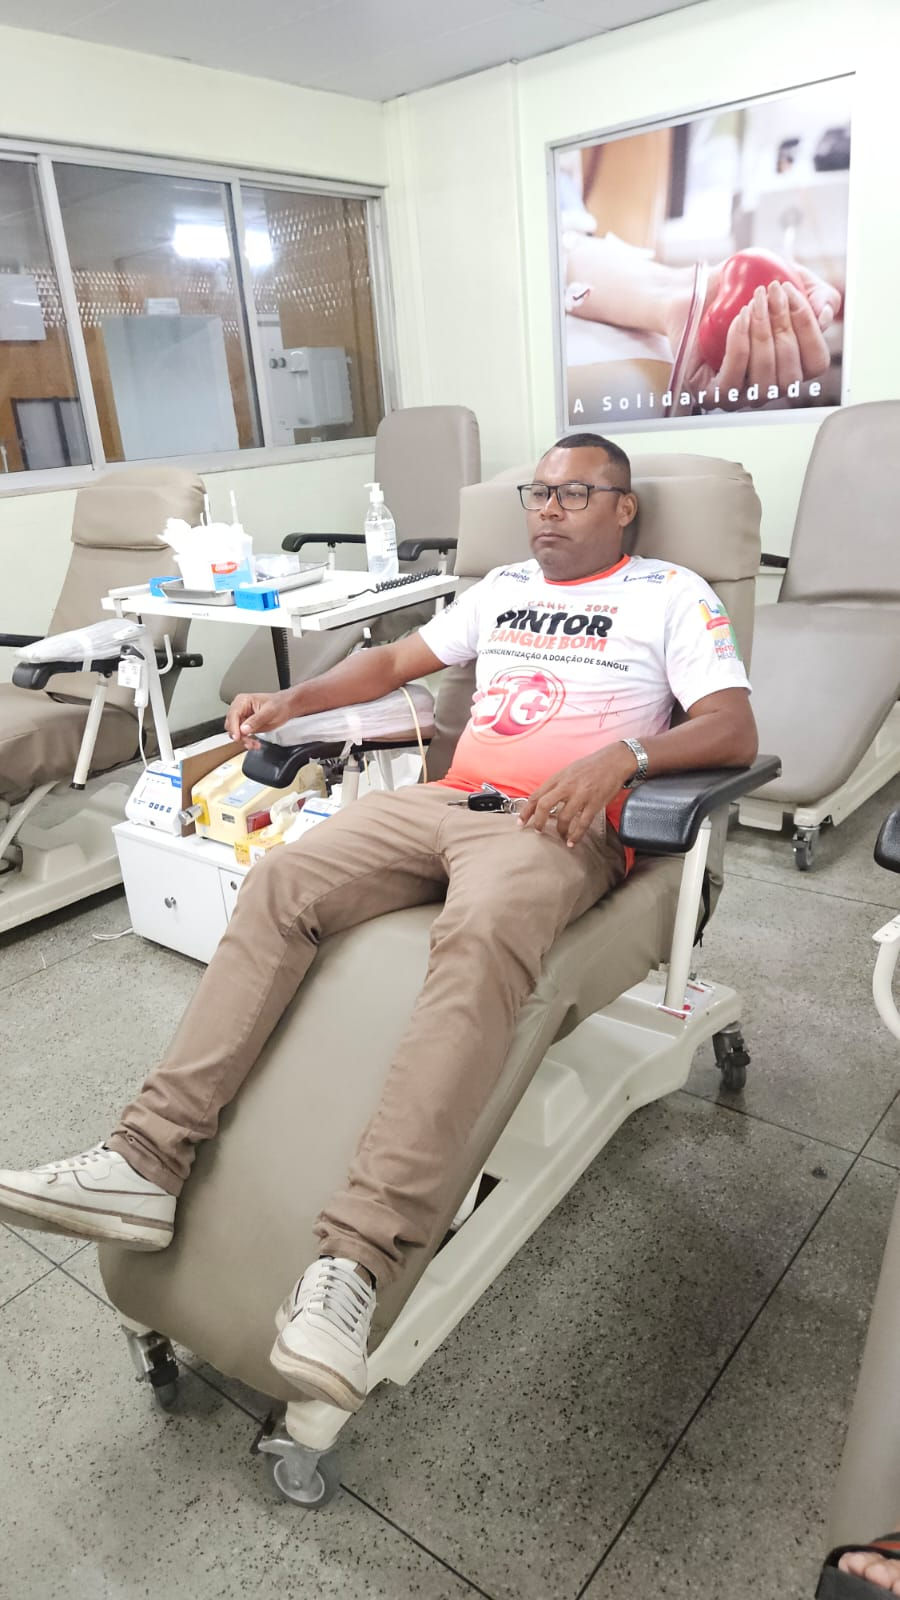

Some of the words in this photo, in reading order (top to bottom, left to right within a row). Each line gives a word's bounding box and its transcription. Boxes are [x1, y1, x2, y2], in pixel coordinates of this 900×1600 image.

[573, 398, 585, 414] A
[602, 380, 823, 412] Solidariedade
[496, 609, 613, 638] PINTOR
[488, 629, 557, 650] SANGUE
[557, 636, 608, 653] BOM
[482, 648, 542, 660] ONSCIENTIZAÇÃO
[542, 652, 549, 661] A
[549, 654, 583, 665] DOAÇÃO
[595, 659, 630, 672] SANGUE
